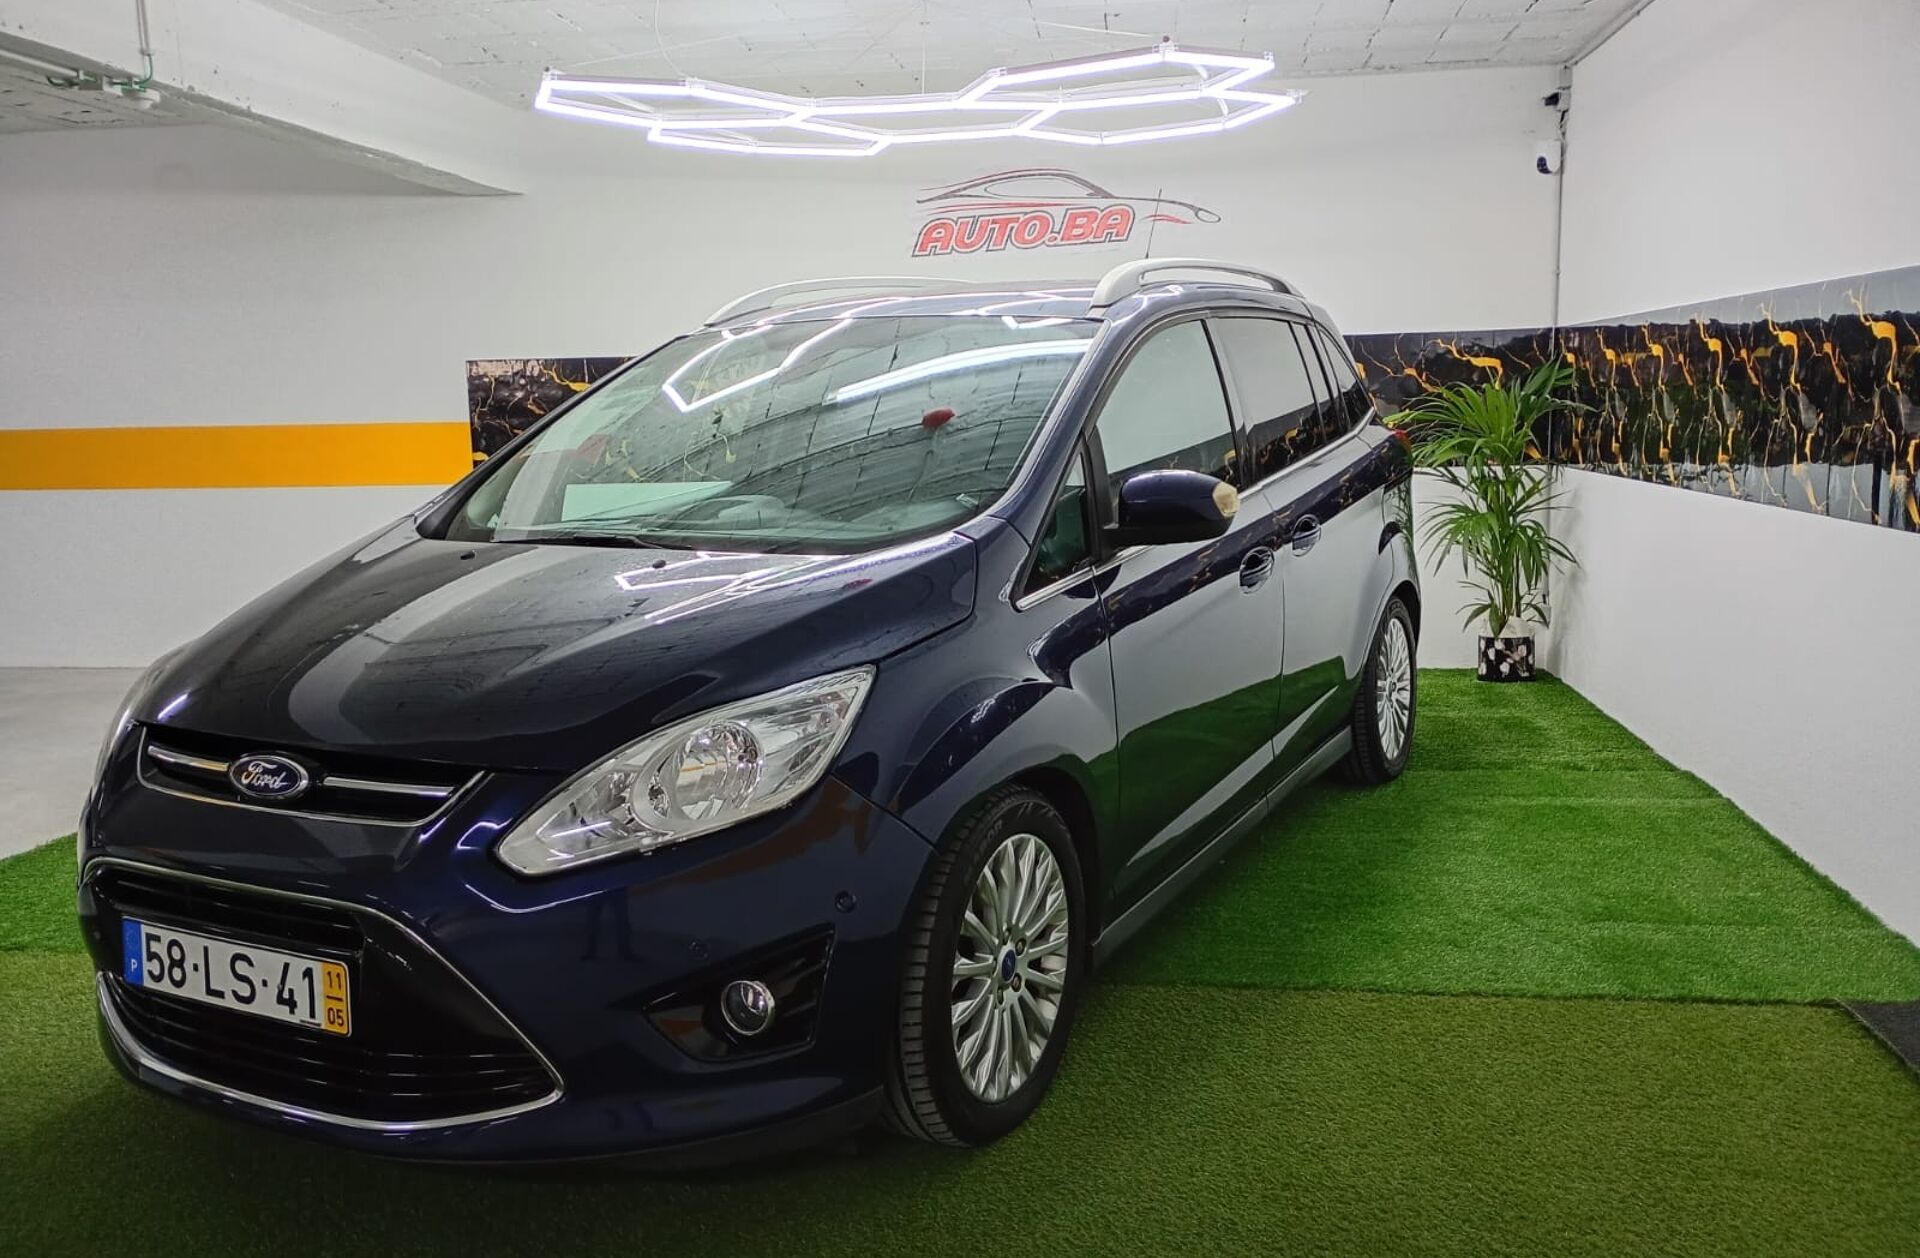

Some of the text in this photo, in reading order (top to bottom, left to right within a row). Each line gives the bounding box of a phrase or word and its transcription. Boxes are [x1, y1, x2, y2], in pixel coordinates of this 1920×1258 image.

[912, 204, 1136, 258] AUTO.BA
[241, 760, 290, 790] Ford
[130, 957, 138, 973] P
[326, 970, 342, 991] 11
[327, 1006, 345, 1028] 05
